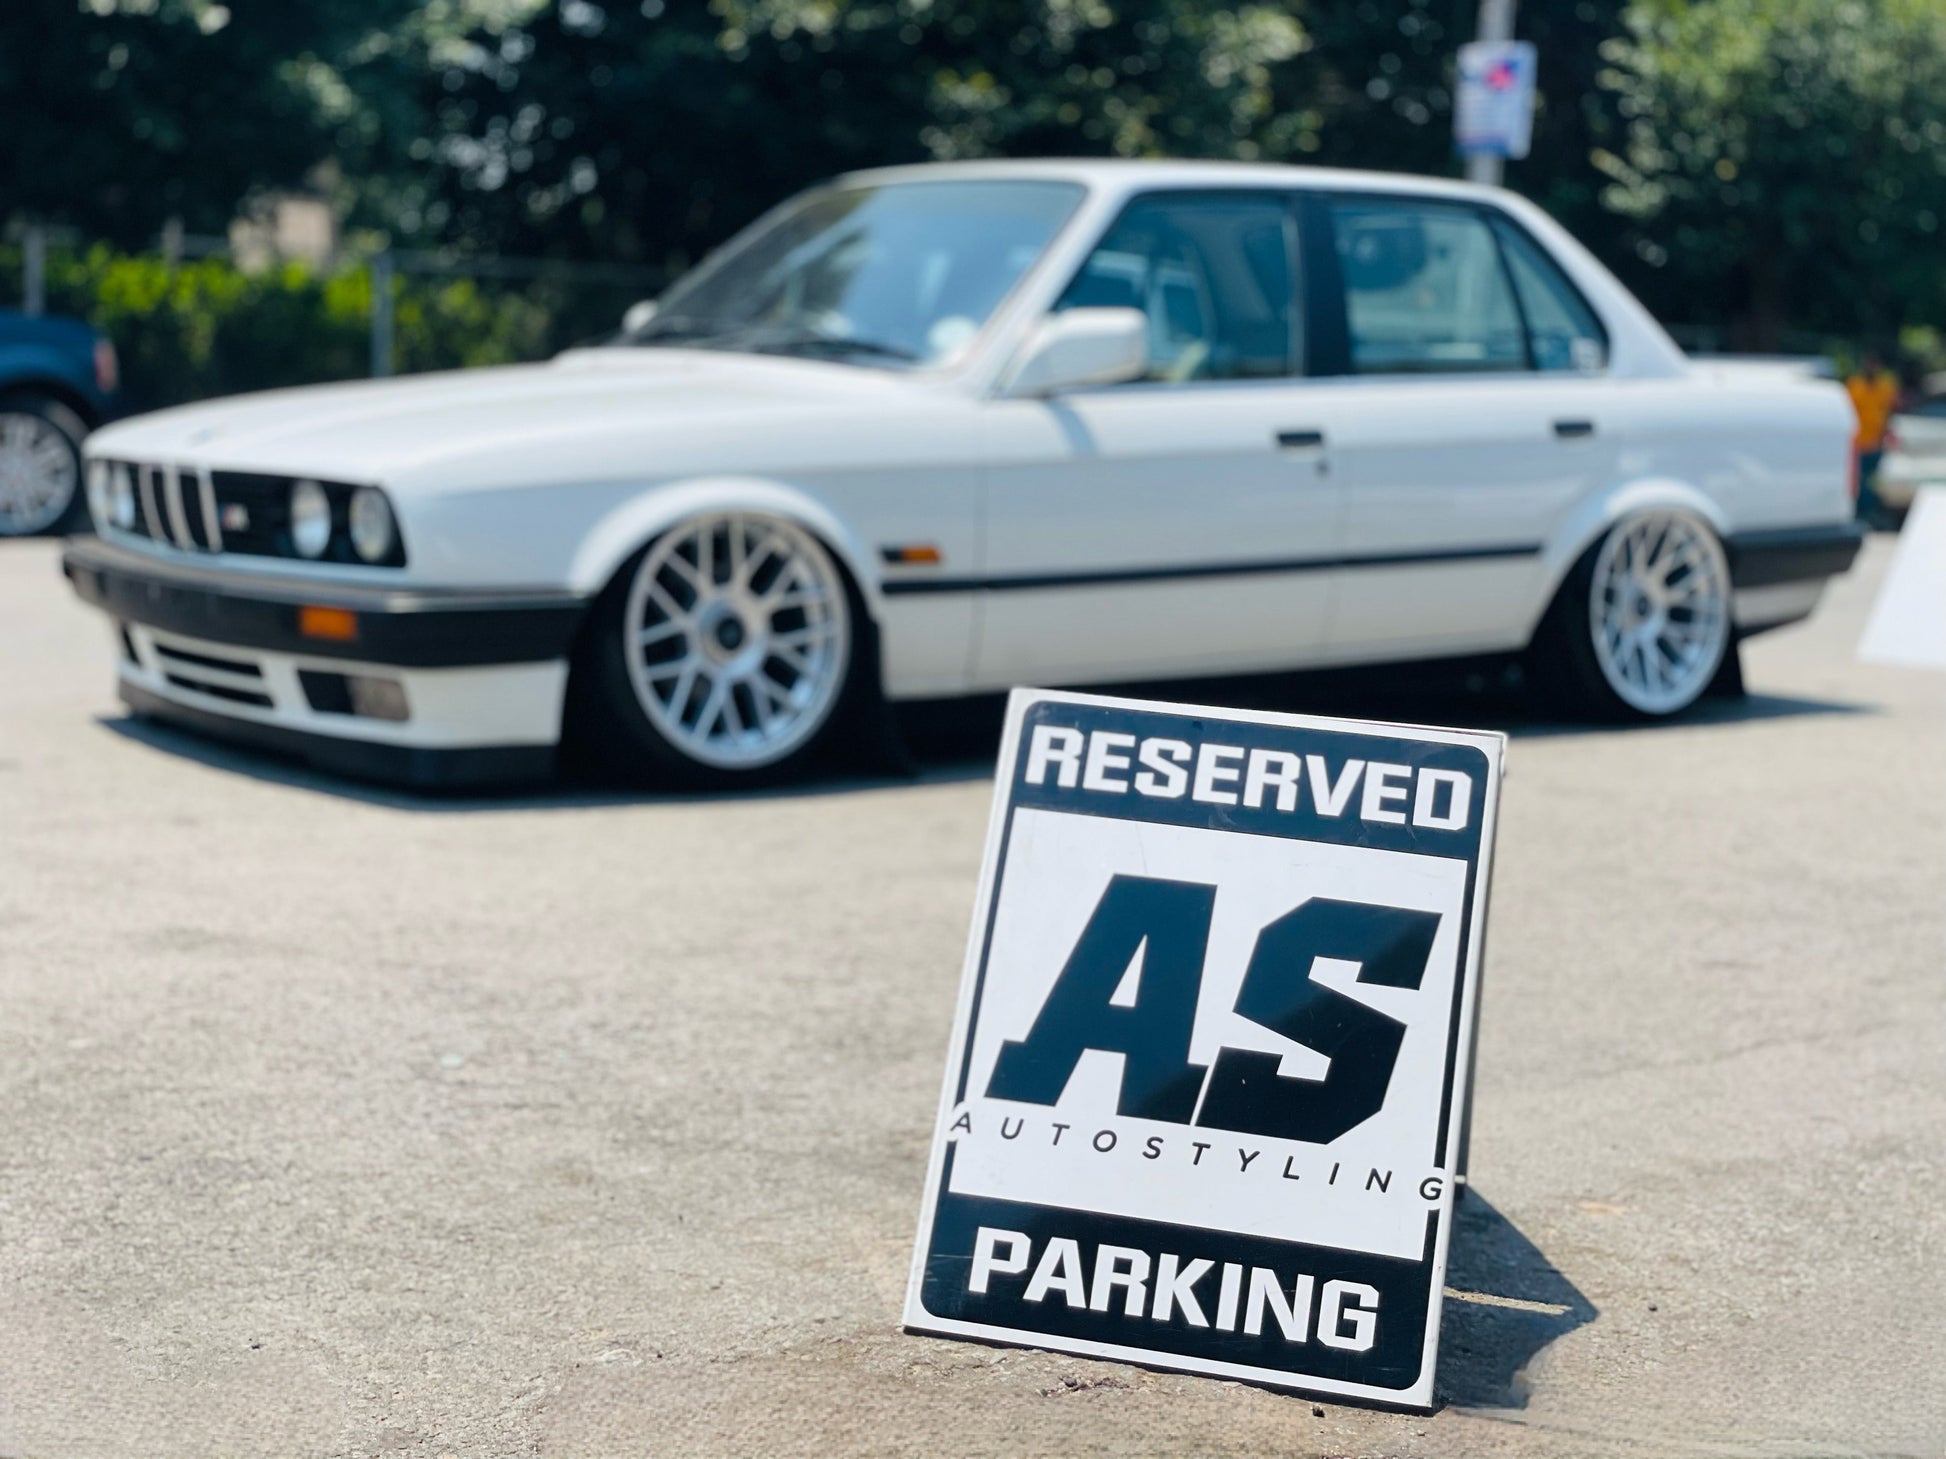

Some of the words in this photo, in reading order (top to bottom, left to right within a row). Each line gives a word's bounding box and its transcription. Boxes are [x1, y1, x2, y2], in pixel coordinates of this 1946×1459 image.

[1025, 725, 1472, 831] RESERVED
[984, 873, 1443, 1145] AS
[950, 1111, 1443, 1202] AUTOSTYLING
[968, 1226, 1380, 1352] PARKING
